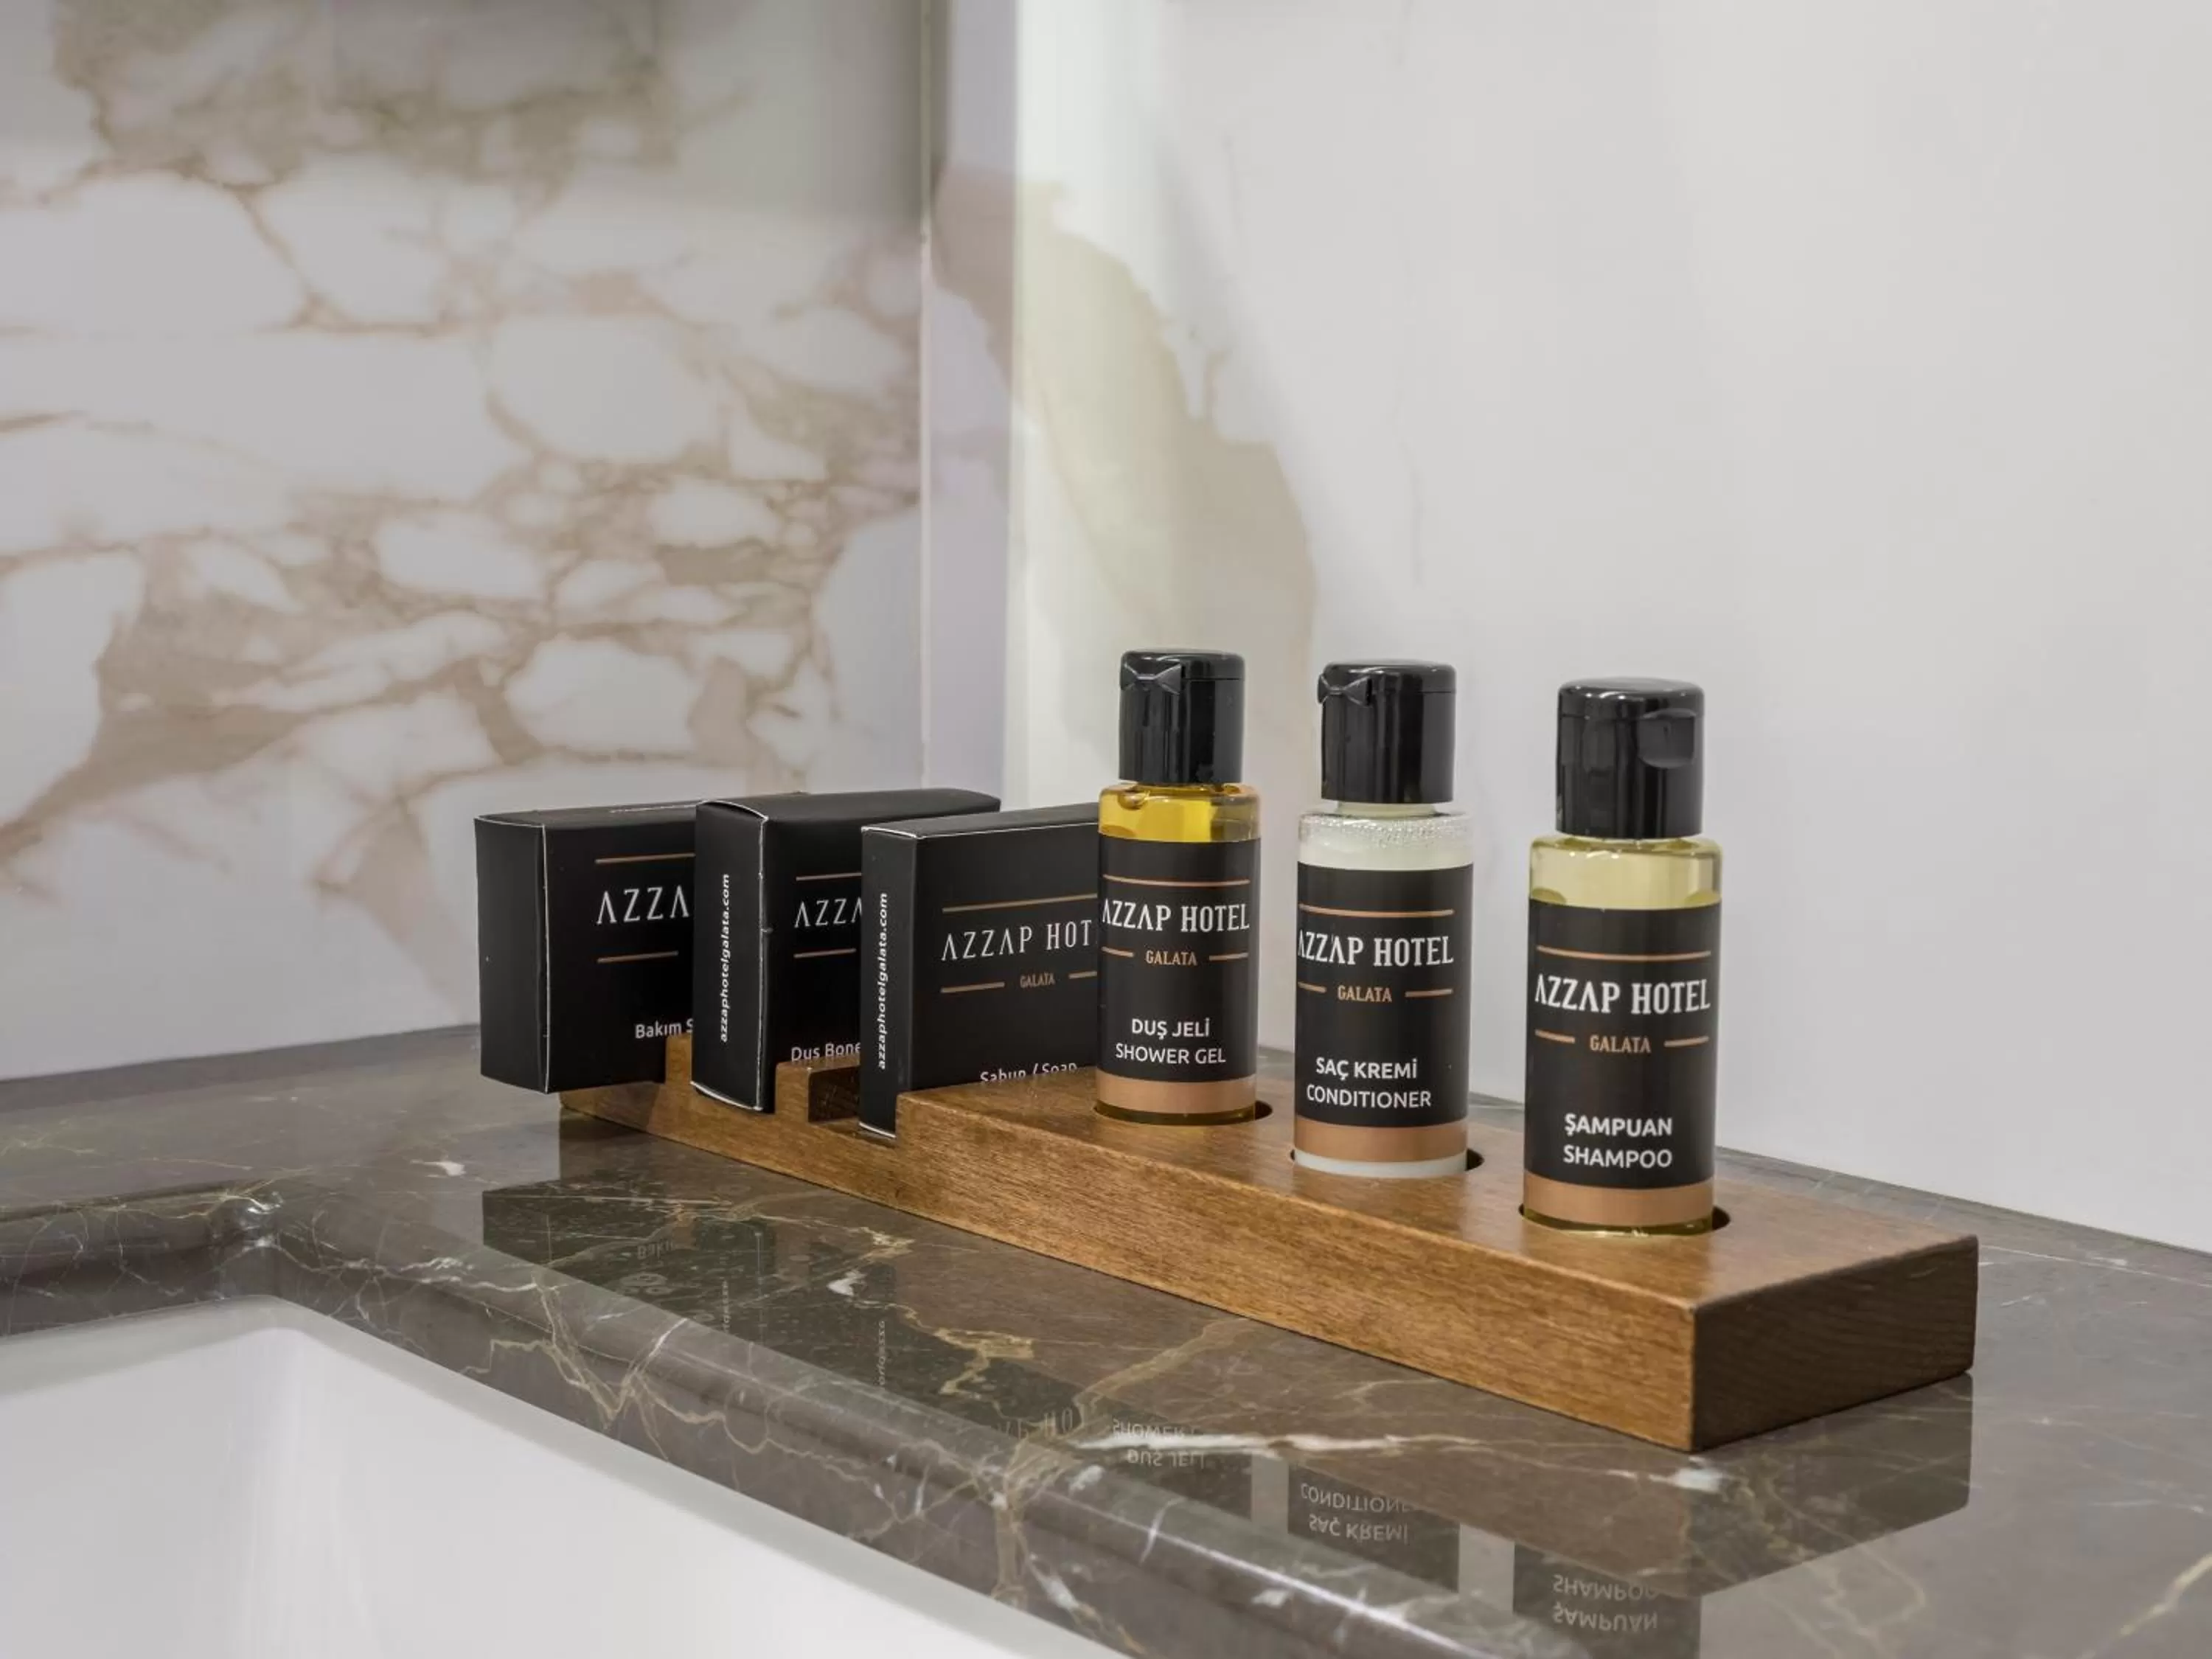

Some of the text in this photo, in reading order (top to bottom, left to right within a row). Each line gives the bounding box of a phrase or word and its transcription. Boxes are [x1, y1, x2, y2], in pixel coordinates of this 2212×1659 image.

[596, 885, 690, 925] AZZA
[794, 896, 861, 928] AZZA
[1102, 898, 1251, 933] AZZAP HOTEL
[941, 919, 1093, 961] AZZAP HOT
[1298, 929, 1454, 967] AZZAP HOTEL
[720, 873, 731, 1043] azzaphotelgalata.com
[1146, 949, 1198, 967] GALATA
[877, 892, 888, 1070] azzaphotelgalata.com
[1019, 972, 1056, 989] GALATA
[1337, 984, 1393, 1003] GALATA
[1534, 973, 1711, 1015] AZZAP HOTEL
[1131, 1017, 1210, 1040] DUŞ JELİ
[825, 1042, 861, 1057] Bone
[1115, 1042, 1227, 1065] SHOWER GEL
[1589, 1034, 1652, 1054] GALATA
[1315, 1057, 1418, 1081] SAÇ KREMİ
[1306, 1083, 1432, 1108] CONDITIONER
[1564, 1113, 1673, 1137] ŞAMPUAN
[1562, 1144, 1673, 1169] SHAMPOO
